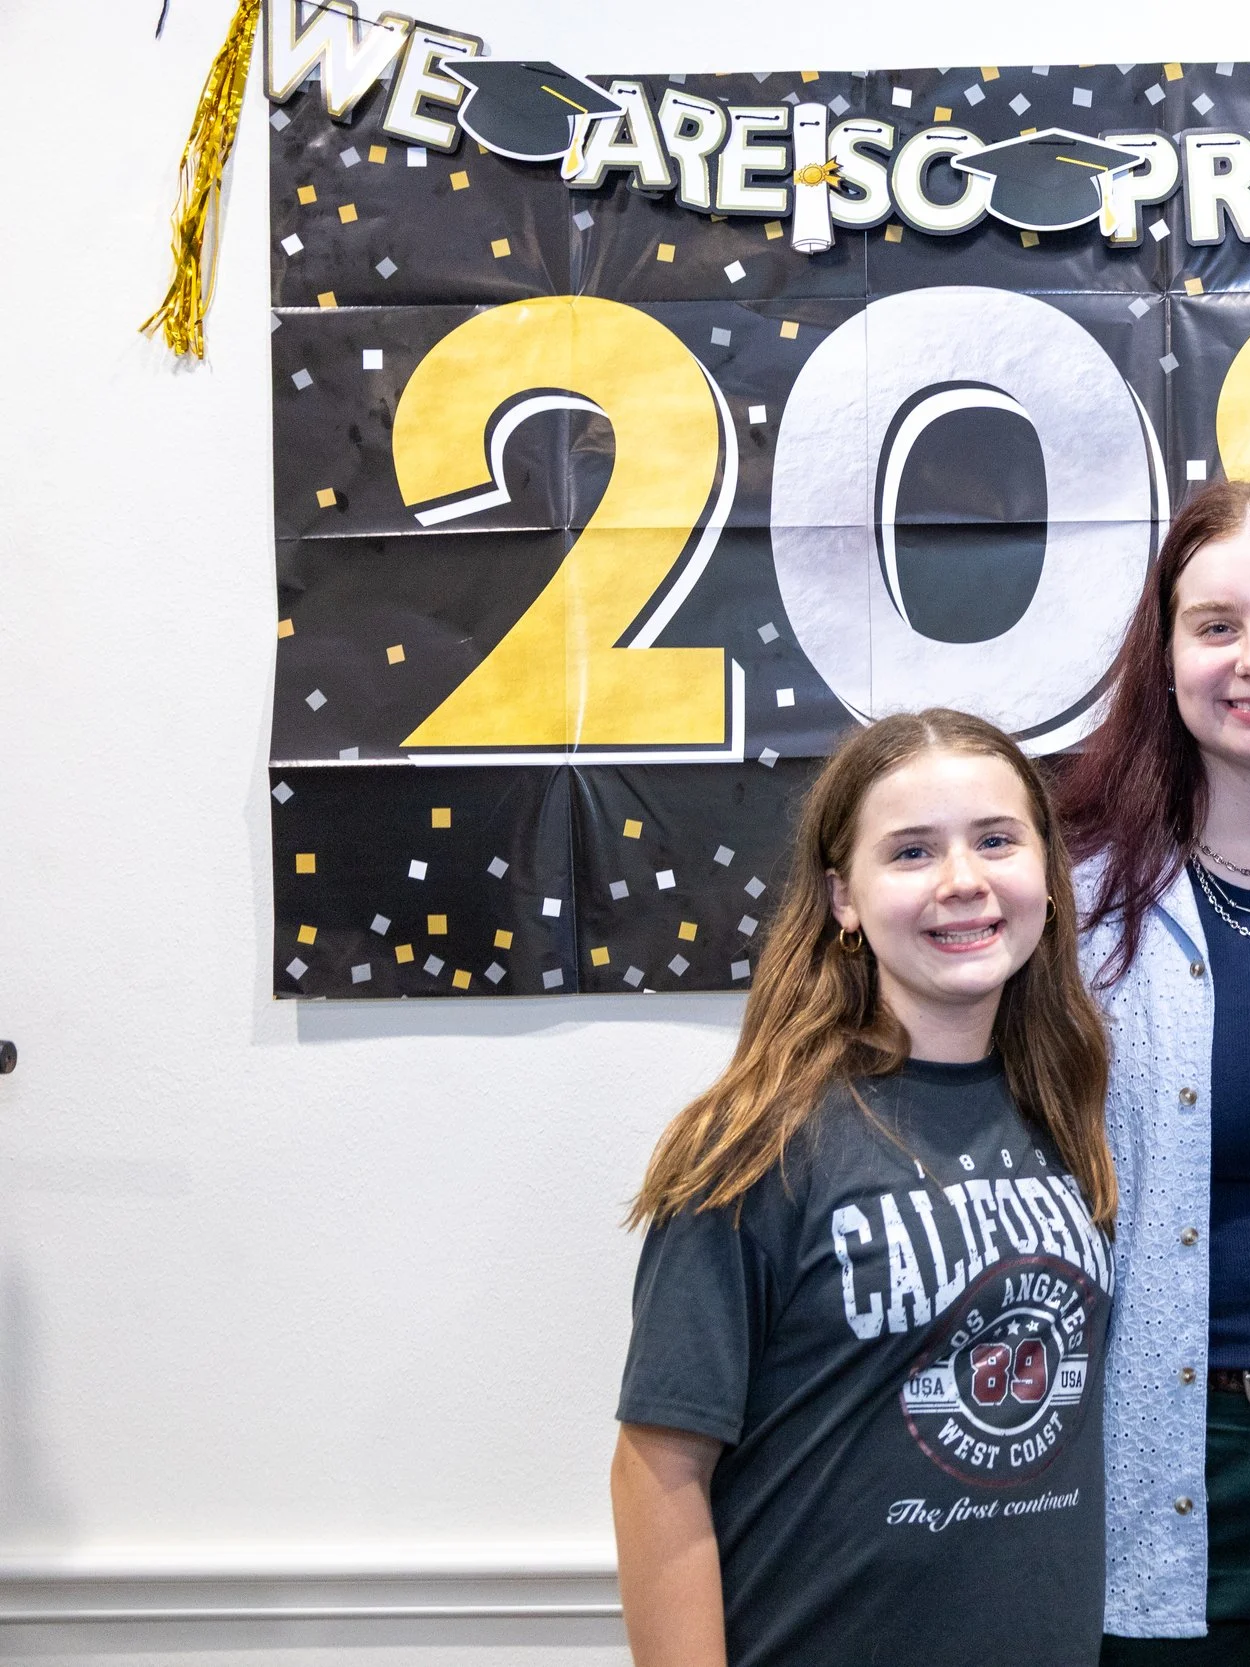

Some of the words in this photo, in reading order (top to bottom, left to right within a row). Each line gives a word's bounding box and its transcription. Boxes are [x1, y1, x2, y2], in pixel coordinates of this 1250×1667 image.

[265, 0, 478, 152] WE
[566, 80, 792, 214] ARE
[828, 118, 993, 235] SO
[914, 1149, 1047, 1179] 1889
[1001, 1272, 1086, 1350] ANGELES
[908, 1377, 945, 1397] USA
[969, 1337, 1048, 1407] 89
[1060, 1370, 1082, 1389] USA
[937, 1417, 1000, 1469] WEST
[1009, 1410, 1063, 1468] COAST
[886, 1498, 942, 1526] The
[928, 1496, 1000, 1533] first
[1003, 1488, 1079, 1518] continent
